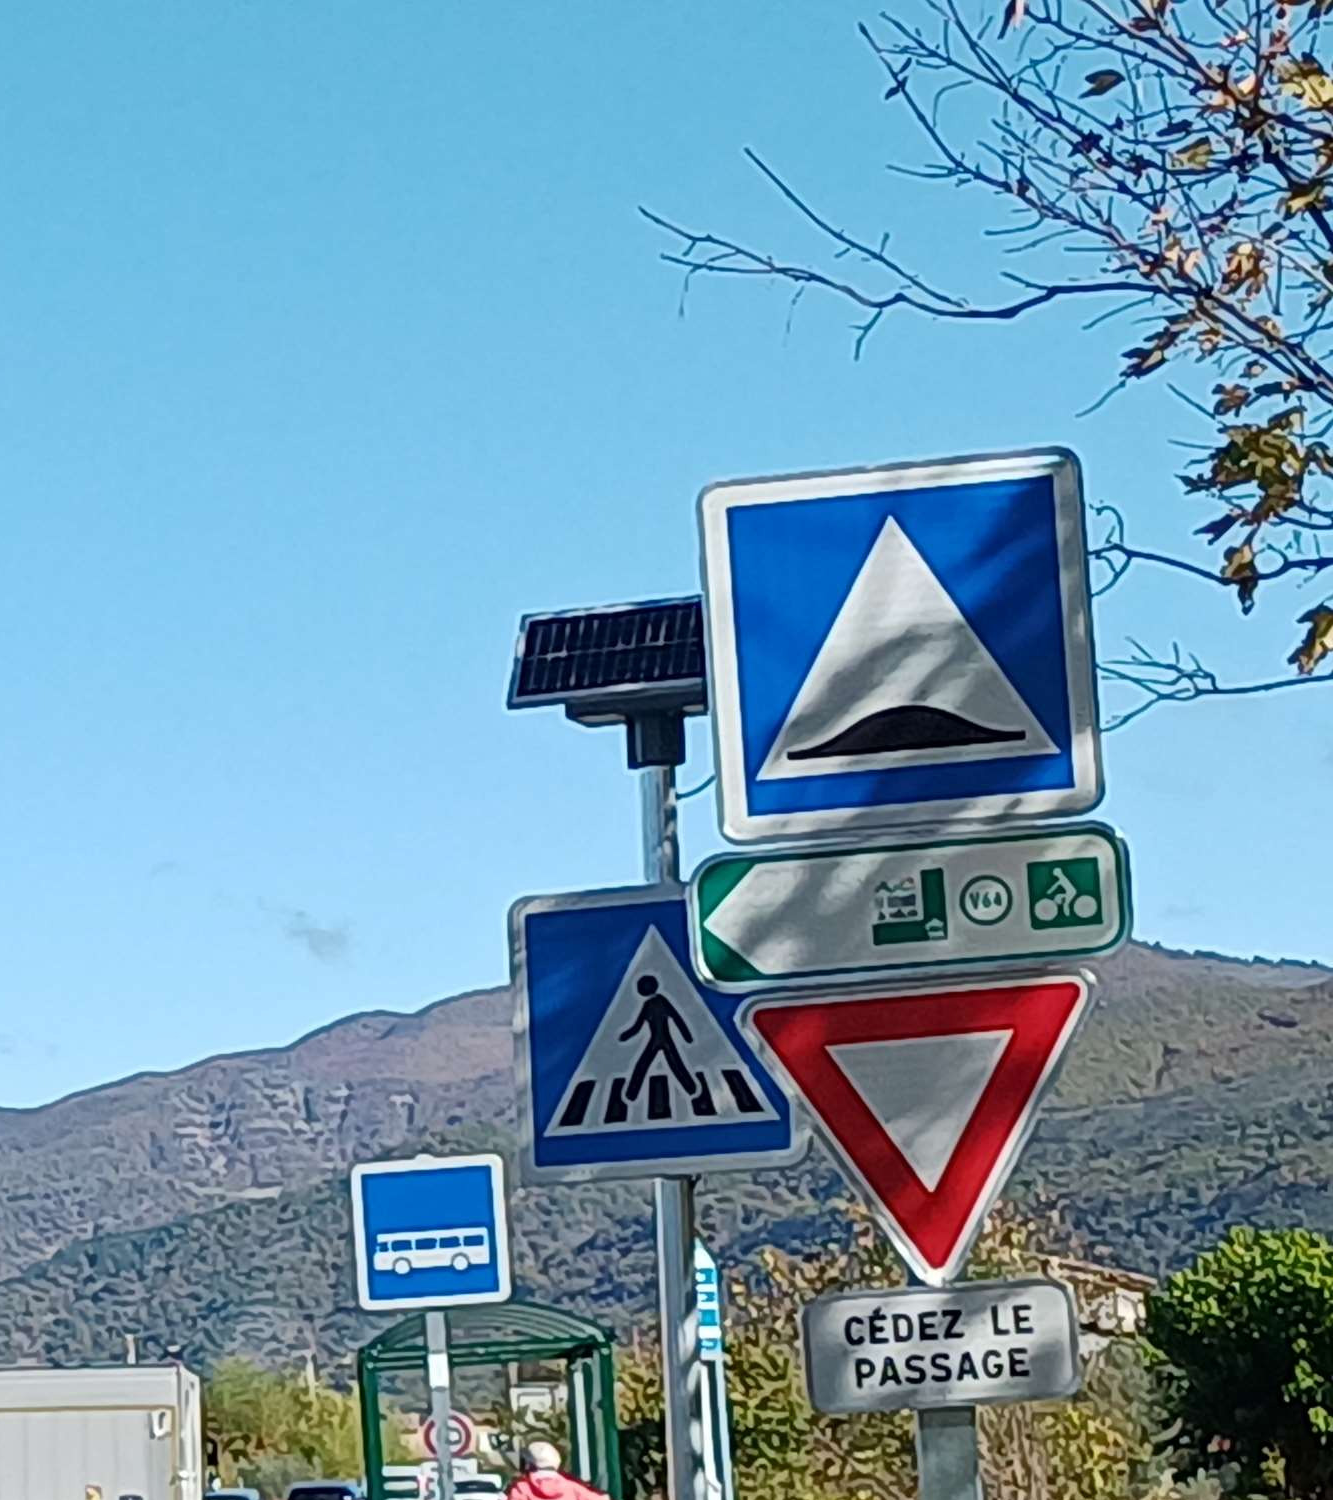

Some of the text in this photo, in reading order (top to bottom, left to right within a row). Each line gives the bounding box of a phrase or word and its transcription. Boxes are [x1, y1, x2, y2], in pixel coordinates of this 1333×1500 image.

[844, 1304, 1033, 1346] CÉDEZ LE
[854, 1348, 1030, 1389] PASSAGE
